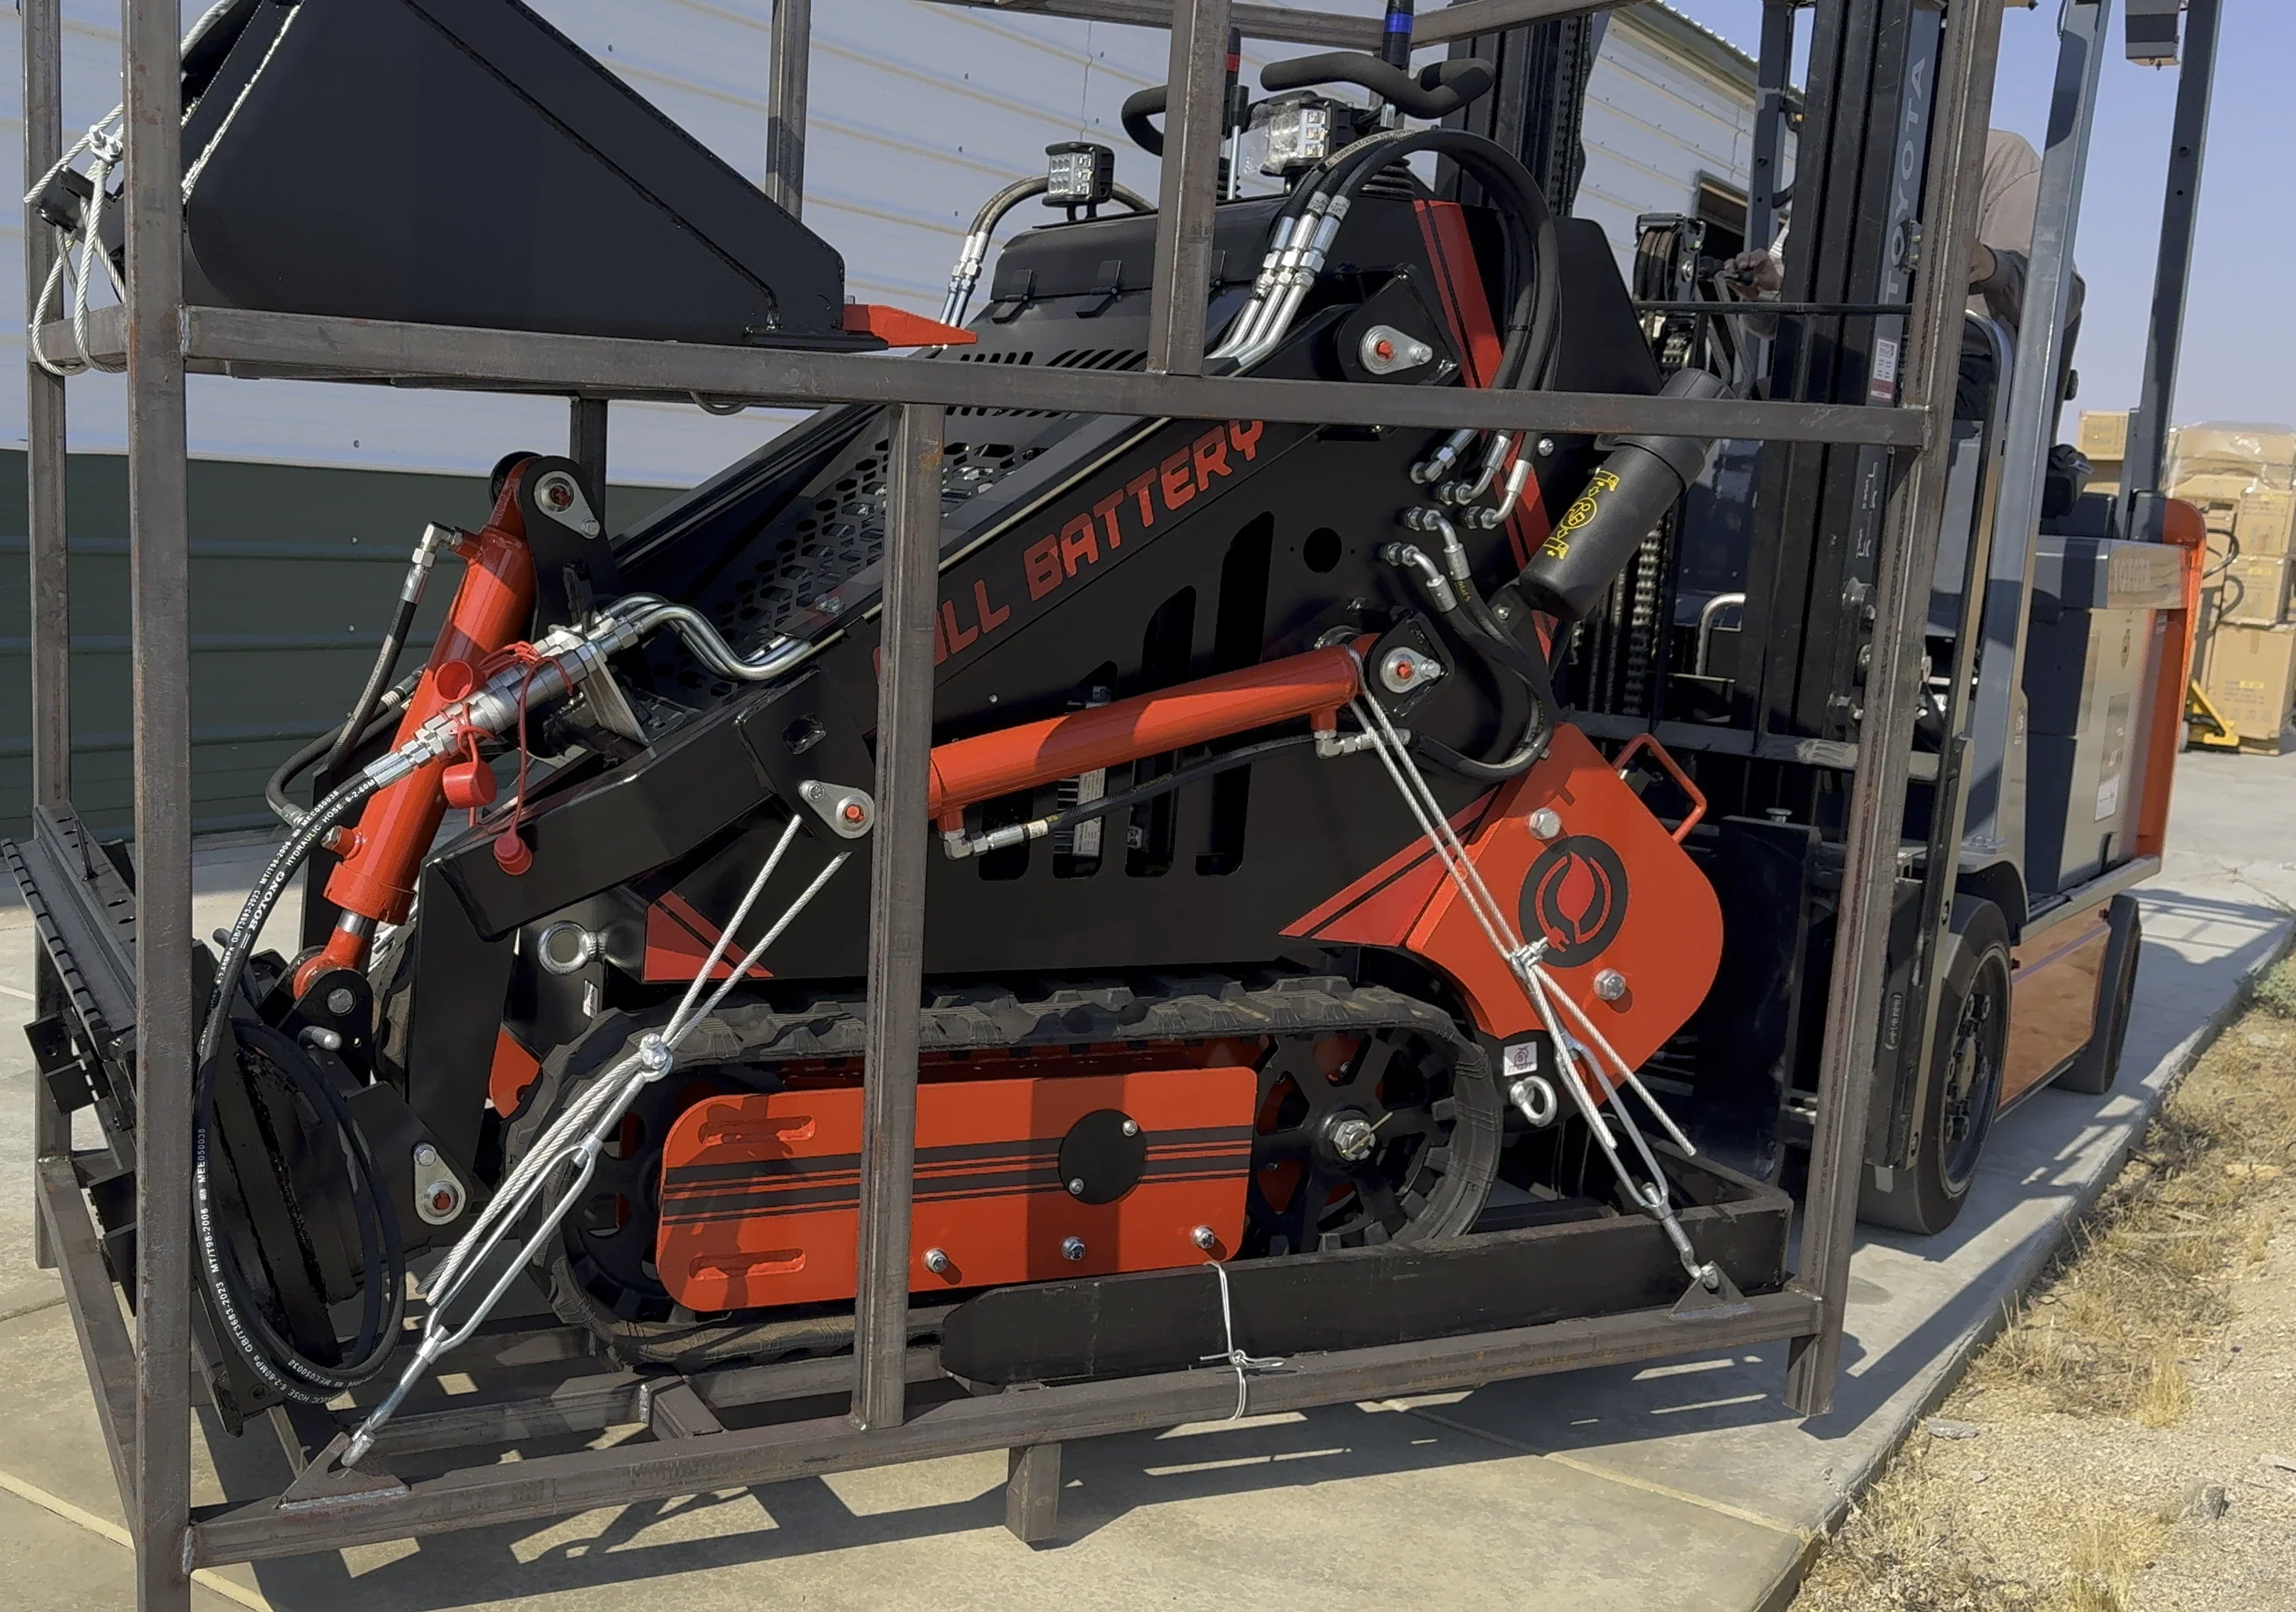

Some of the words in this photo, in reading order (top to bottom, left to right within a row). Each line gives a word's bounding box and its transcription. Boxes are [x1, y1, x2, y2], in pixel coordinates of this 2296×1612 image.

[1885, 57, 1925, 304] TOYOTA
[1023, 419, 1263, 602] BATTERY
[248, 871, 285, 932] BOTONG
[285, 824, 322, 866] HYDRAULIC
[322, 803, 344, 824] HOSE
[197, 1128, 207, 1184] MEE050038
[201, 1208, 219, 1273] MT/T98-2006
[216, 1281, 253, 1352] GB/T3683-2023
[253, 1355, 288, 1391] 6-2-60MPa
[287, 1359, 333, 1386] MEE050038
[288, 1389, 311, 1403] HOSE
